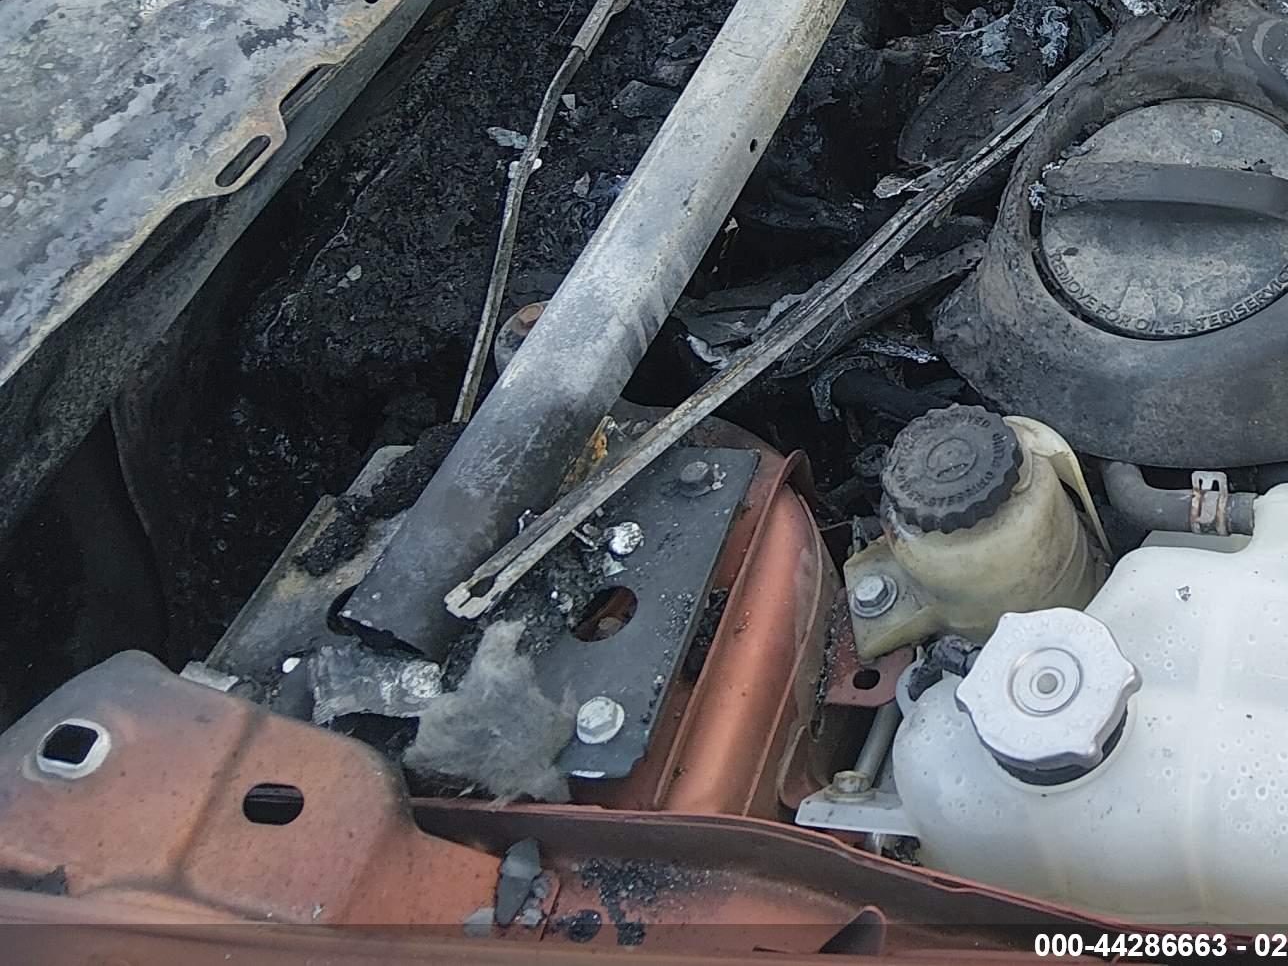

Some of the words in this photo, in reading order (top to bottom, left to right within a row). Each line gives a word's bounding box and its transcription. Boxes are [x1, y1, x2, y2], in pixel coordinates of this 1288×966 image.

[1047, 248, 1098, 309] REMOVE
[1095, 302, 1133, 328] FOR
[1134, 317, 1165, 335] OIL
